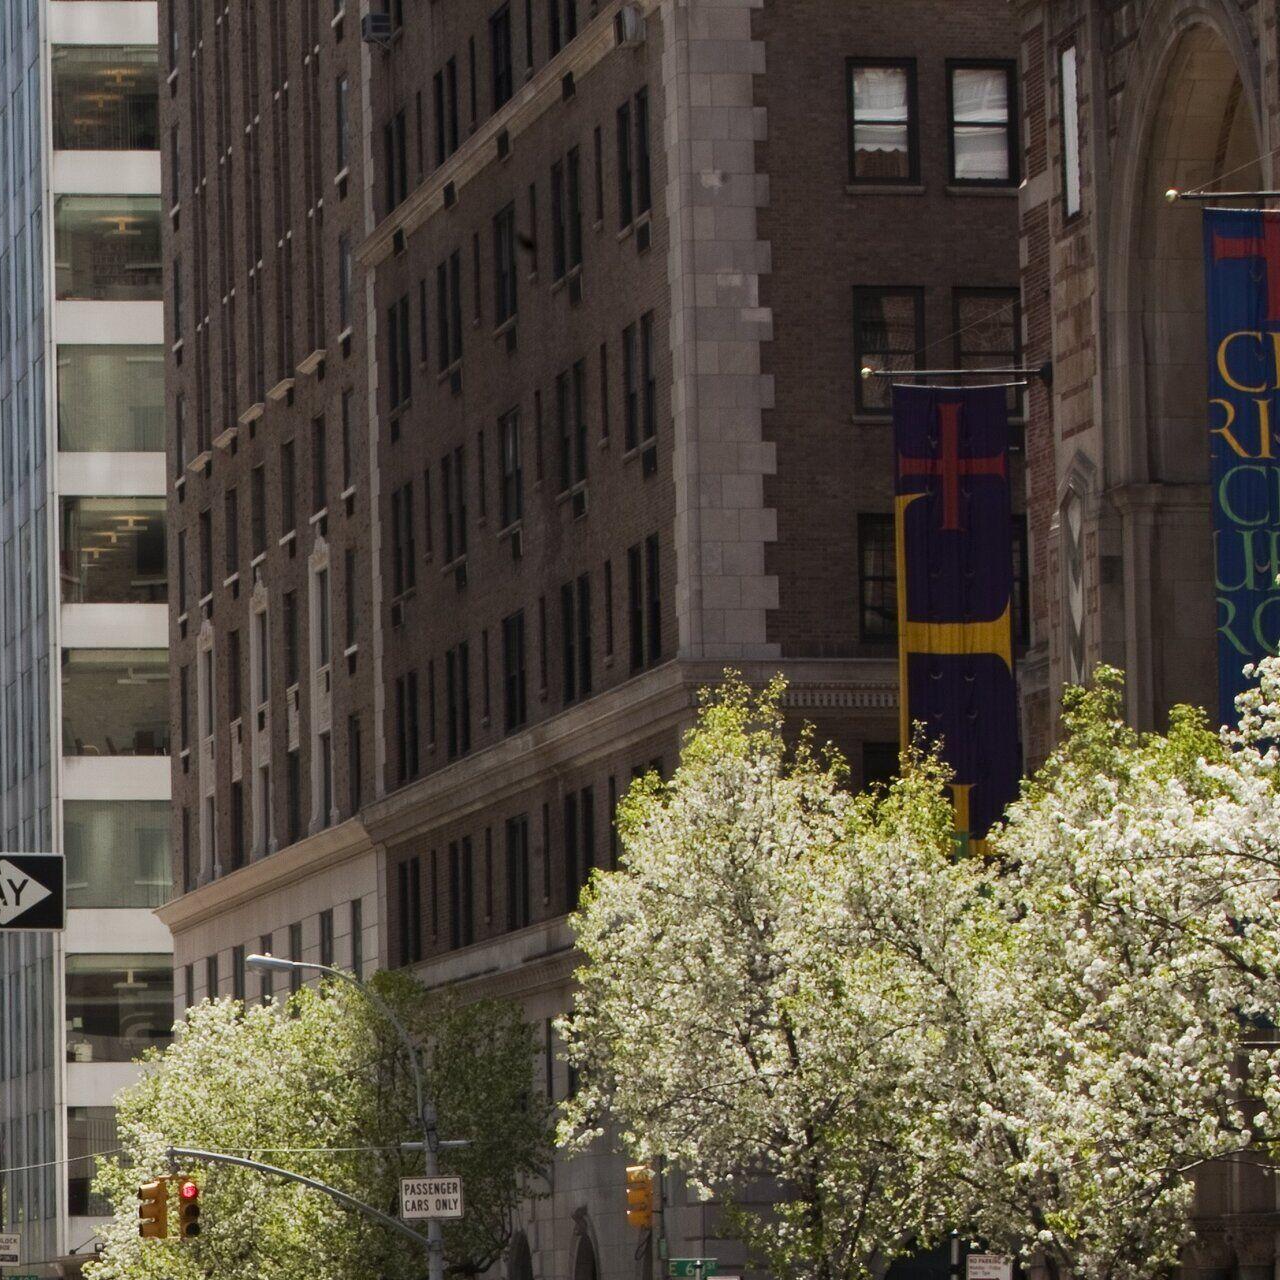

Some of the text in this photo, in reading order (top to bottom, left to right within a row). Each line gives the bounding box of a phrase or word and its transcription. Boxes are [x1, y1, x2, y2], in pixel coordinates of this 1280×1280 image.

[404, 1182, 458, 1196] PASSENGER
[404, 1198, 459, 1212] CARS ONLY
[669, 1262, 677, 1276] E
